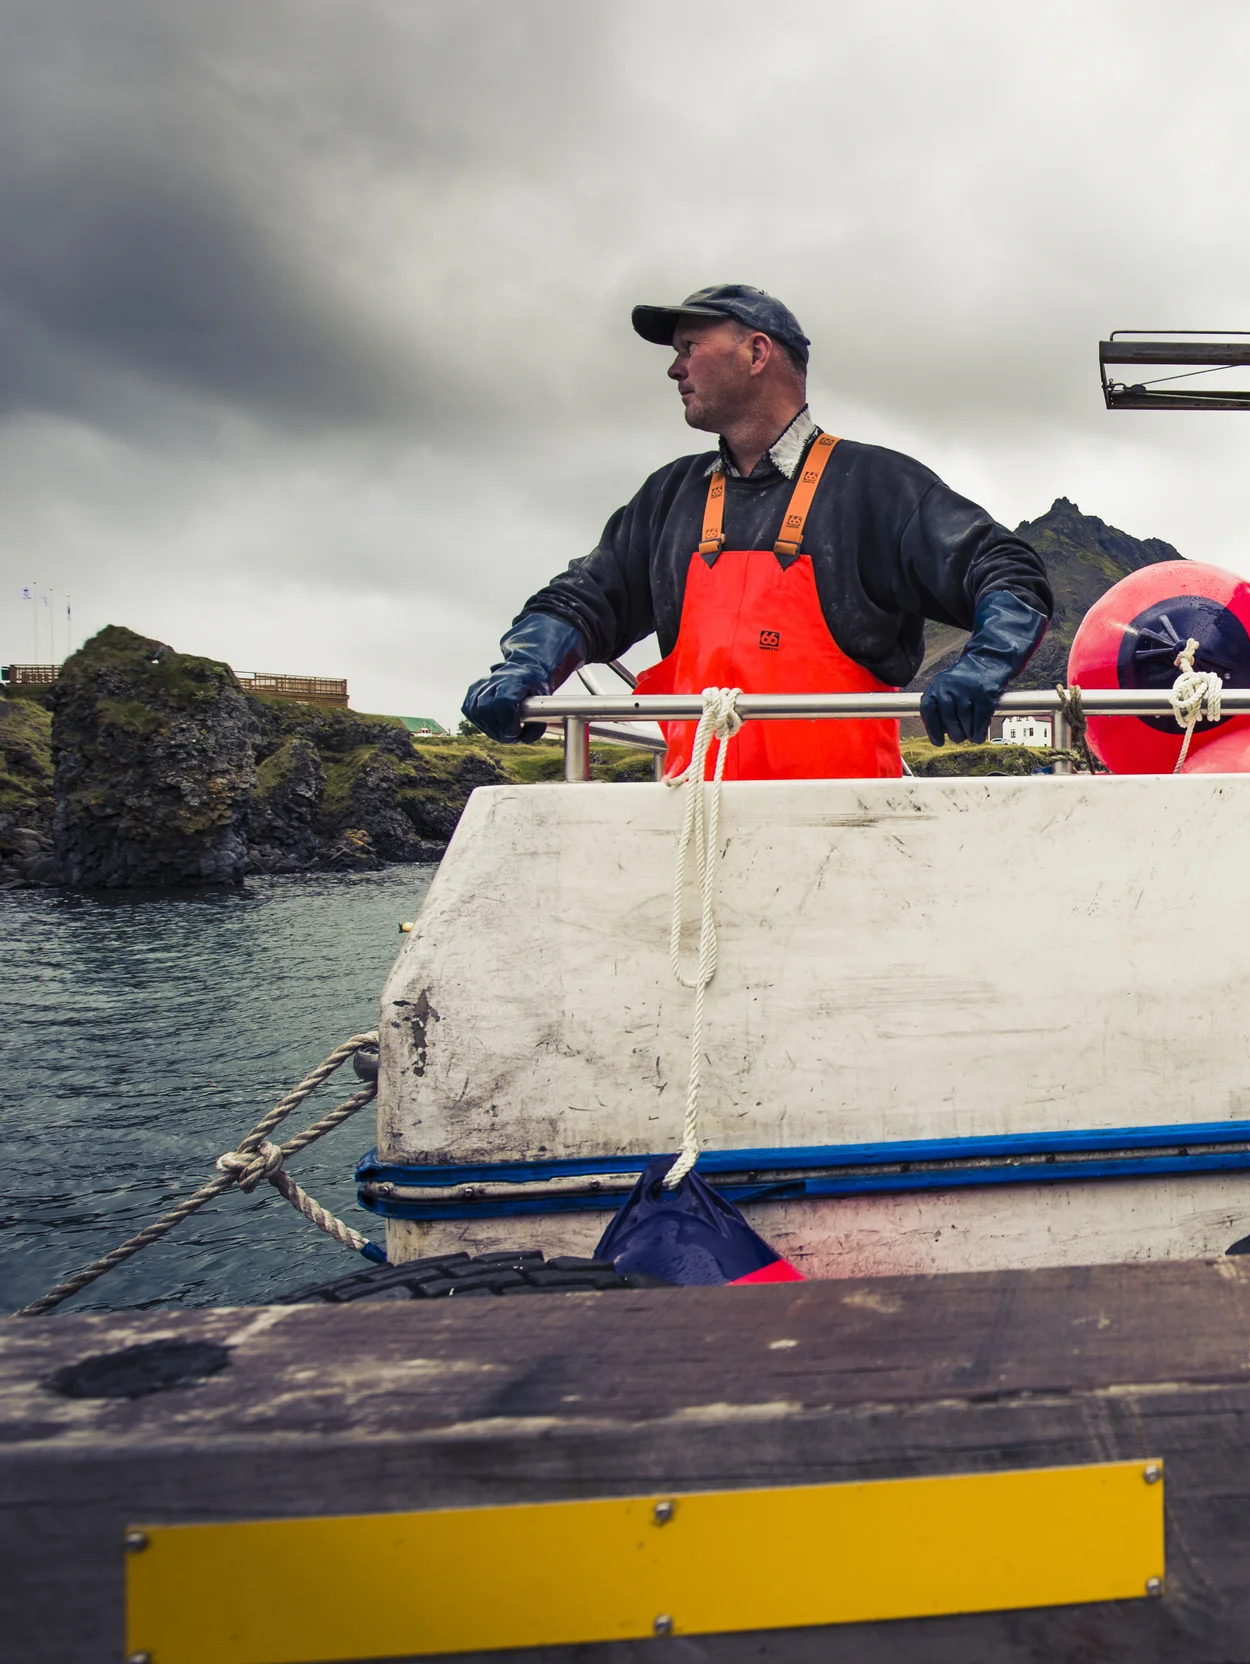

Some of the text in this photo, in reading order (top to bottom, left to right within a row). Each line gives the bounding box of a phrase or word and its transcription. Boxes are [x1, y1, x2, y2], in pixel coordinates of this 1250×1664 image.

[803, 471, 818, 481] 66
[711, 486, 723, 497] 66
[787, 515, 802, 526] 66
[760, 630, 779, 646] 66
